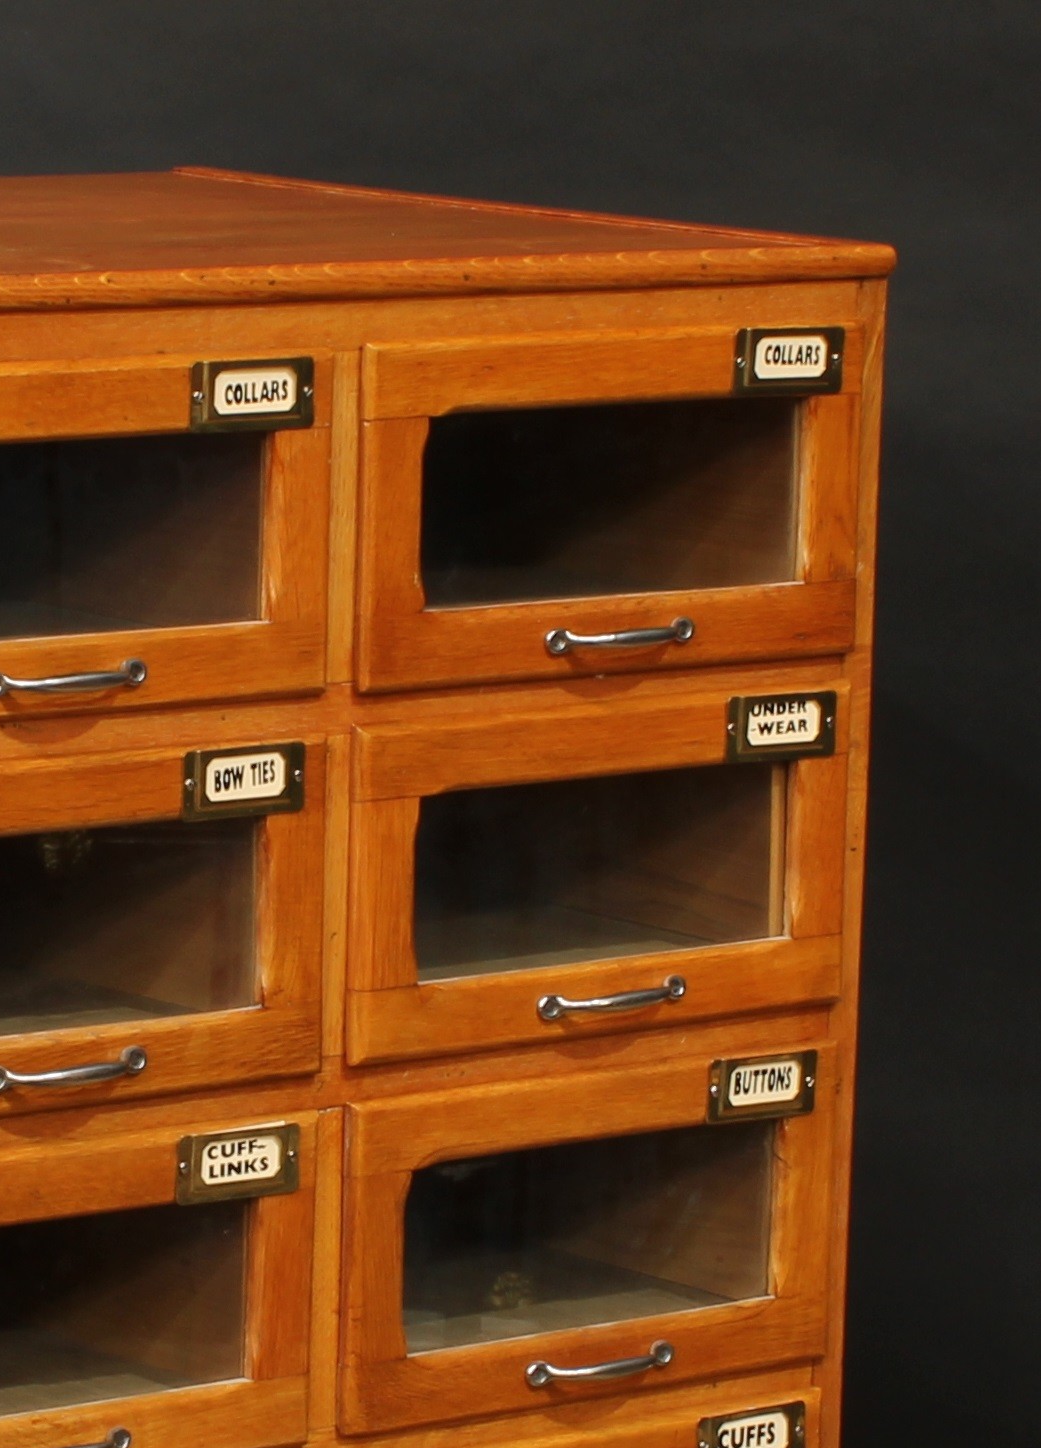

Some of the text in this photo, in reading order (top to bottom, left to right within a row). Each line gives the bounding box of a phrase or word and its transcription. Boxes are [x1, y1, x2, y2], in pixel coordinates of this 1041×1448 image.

[765, 344, 820, 366] COLLARS
[224, 380, 288, 405] COLLARS
[750, 700, 807, 717] UNDER
[214, 759, 275, 793] BOW TIES
[733, 1066, 792, 1096] BUTTONS
[207, 1138, 267, 1161] CUFF-
[208, 1156, 269, 1179] LINKS
